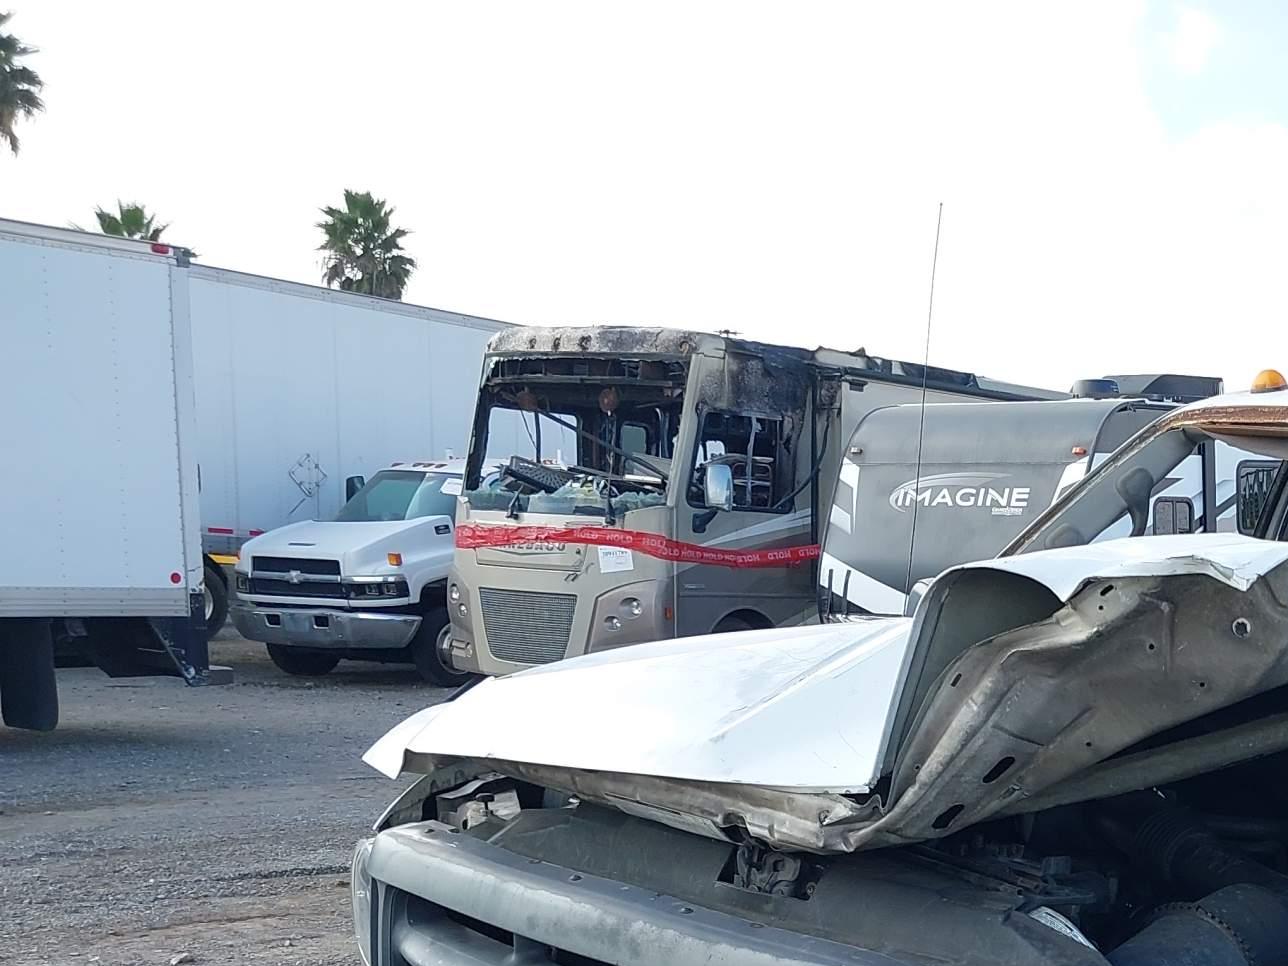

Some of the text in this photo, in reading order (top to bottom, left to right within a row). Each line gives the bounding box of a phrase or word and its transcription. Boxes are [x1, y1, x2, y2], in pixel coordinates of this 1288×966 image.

[897, 487, 1031, 507] IMAGINE
[606, 533, 633, 545] HOLD
[767, 550, 791, 560] HOLD
